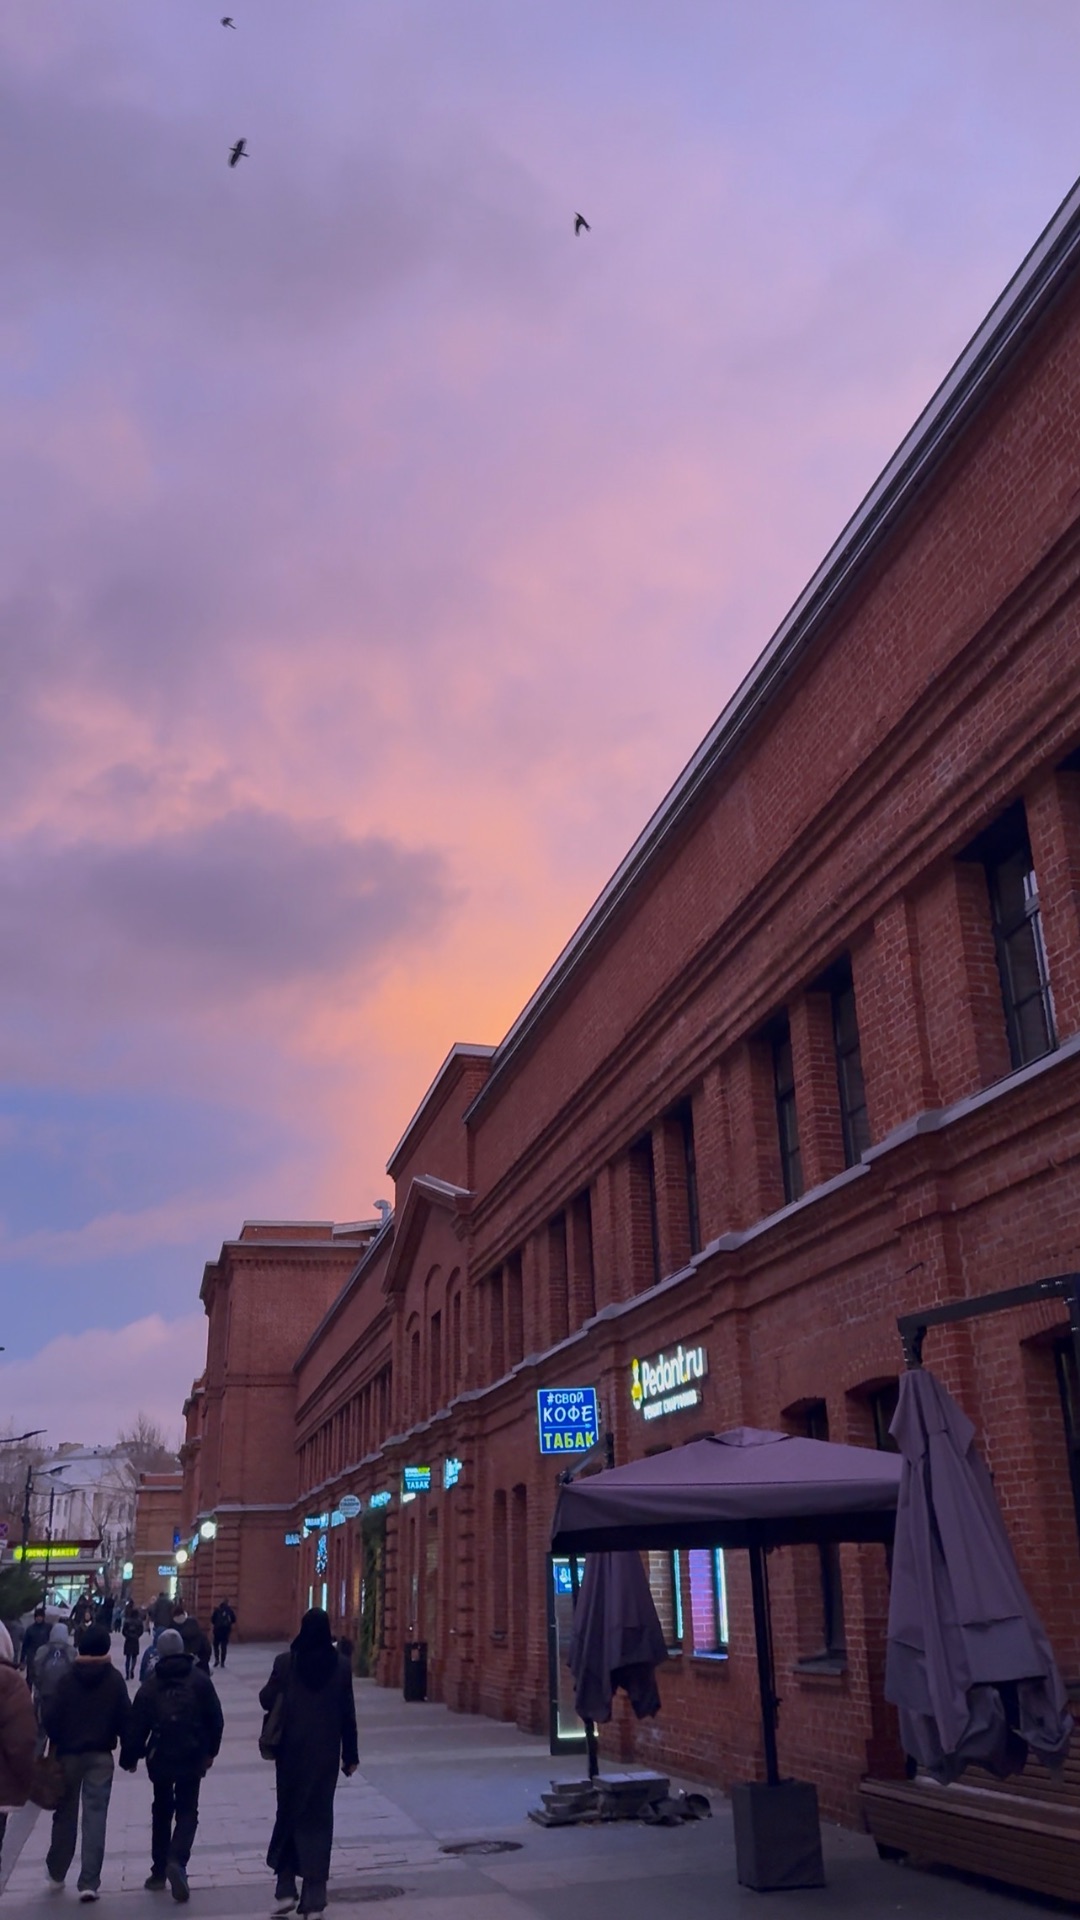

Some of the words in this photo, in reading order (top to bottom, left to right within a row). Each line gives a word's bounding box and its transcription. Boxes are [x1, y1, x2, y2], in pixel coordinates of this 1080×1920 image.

[641, 1345, 704, 1399] Pedant.ru
[547, 1391, 584, 1406] #СВОЙ
[543, 1405, 593, 1423] КОФЕ
[543, 1431, 595, 1449] ТАБАК
